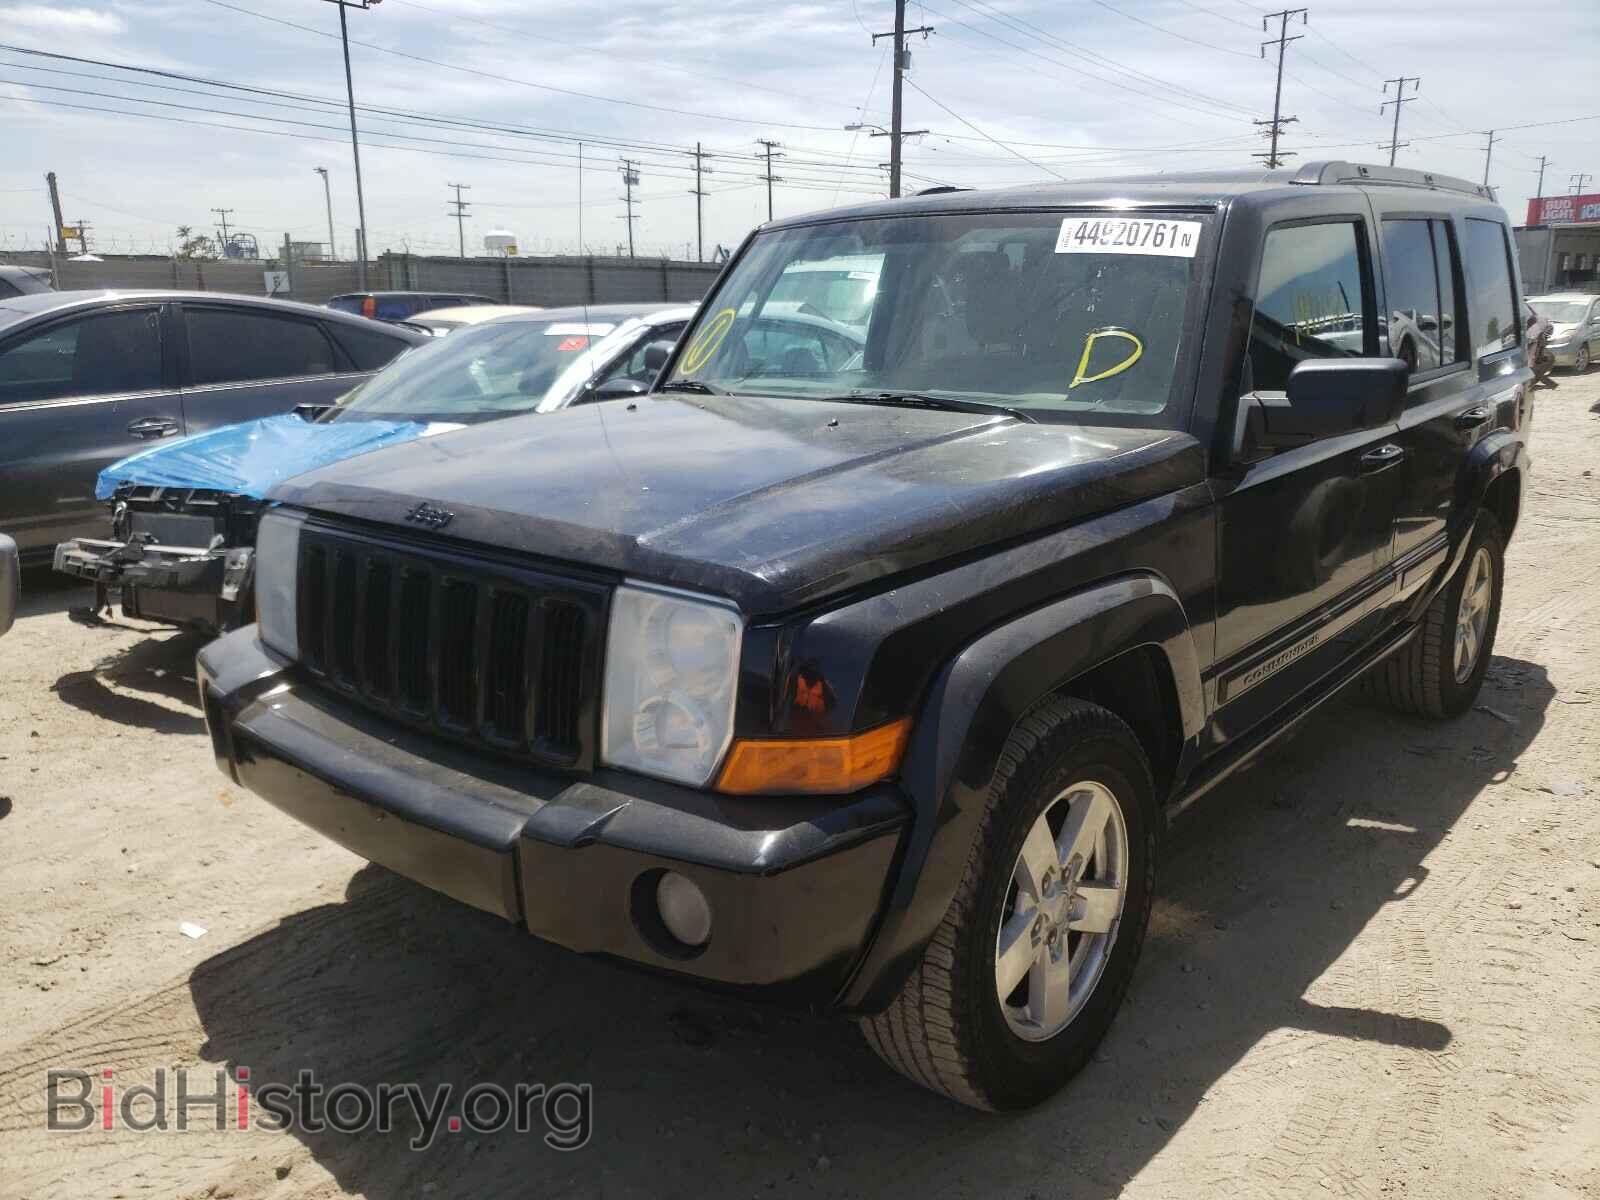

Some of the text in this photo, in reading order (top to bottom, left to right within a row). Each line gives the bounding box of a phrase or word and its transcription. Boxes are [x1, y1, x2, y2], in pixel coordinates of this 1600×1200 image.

[1545, 199, 1572, 209] BUD
[1540, 208, 1575, 219] LIGHT
[1181, 233, 1192, 248] N
[1068, 328, 1143, 389] D
